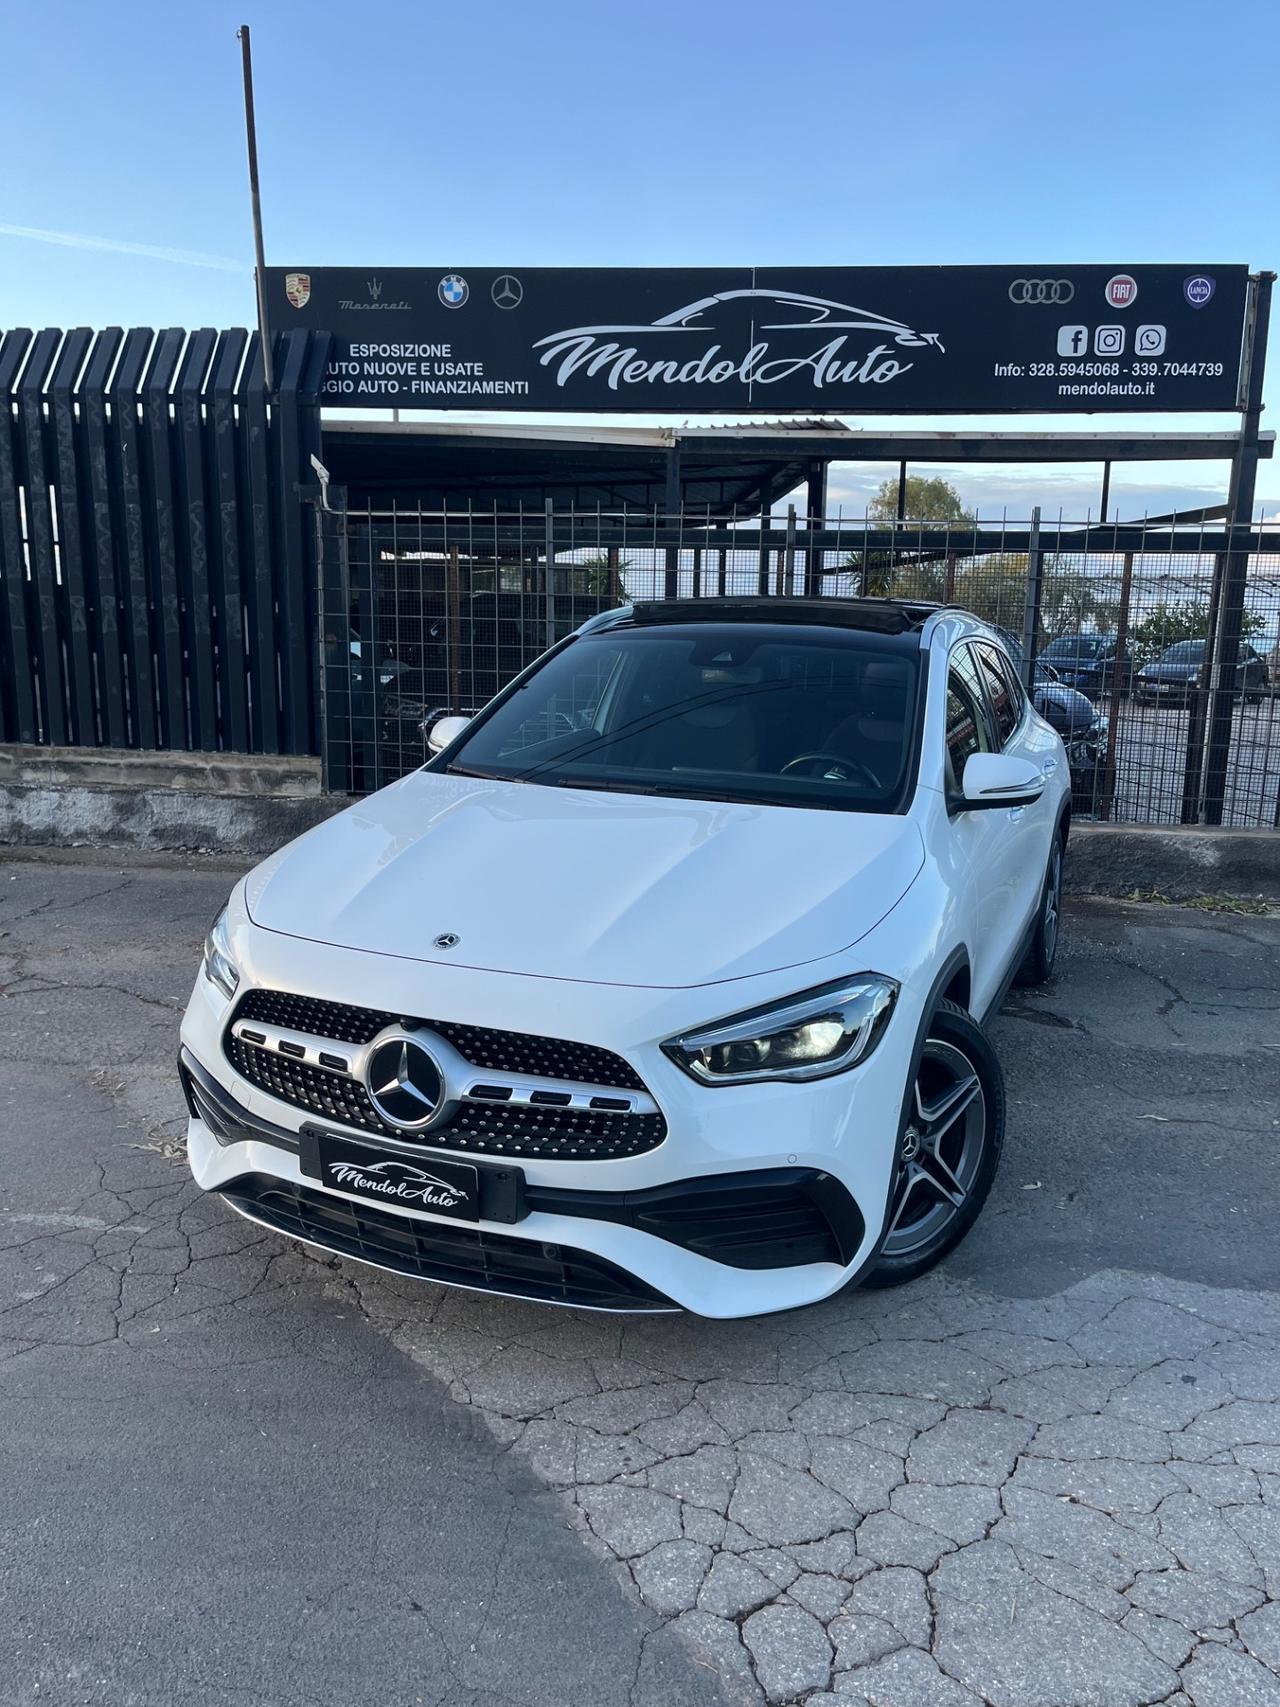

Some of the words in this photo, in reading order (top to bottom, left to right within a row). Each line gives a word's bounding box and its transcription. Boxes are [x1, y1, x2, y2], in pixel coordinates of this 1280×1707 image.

[440, 276, 466, 287] BMW
[1112, 284, 1131, 299] FIAT
[1190, 286, 1208, 295] LANCIA
[338, 300, 413, 310] Maserati
[349, 344, 451, 357] ESPOSIZIONE
[326, 362, 360, 375] UTO
[363, 362, 417, 375] NUOVE
[421, 362, 430, 375] E
[434, 362, 483, 376] USATE
[994, 363, 1025, 376] Info:
[1028, 363, 1120, 376] 328.5945068
[1131, 363, 1223, 376] 339.7044739
[357, 380, 400, 394] AUTO
[411, 380, 529, 395] FINANZIAMENTI
[1058, 382, 1155, 395] mendolauto.it
